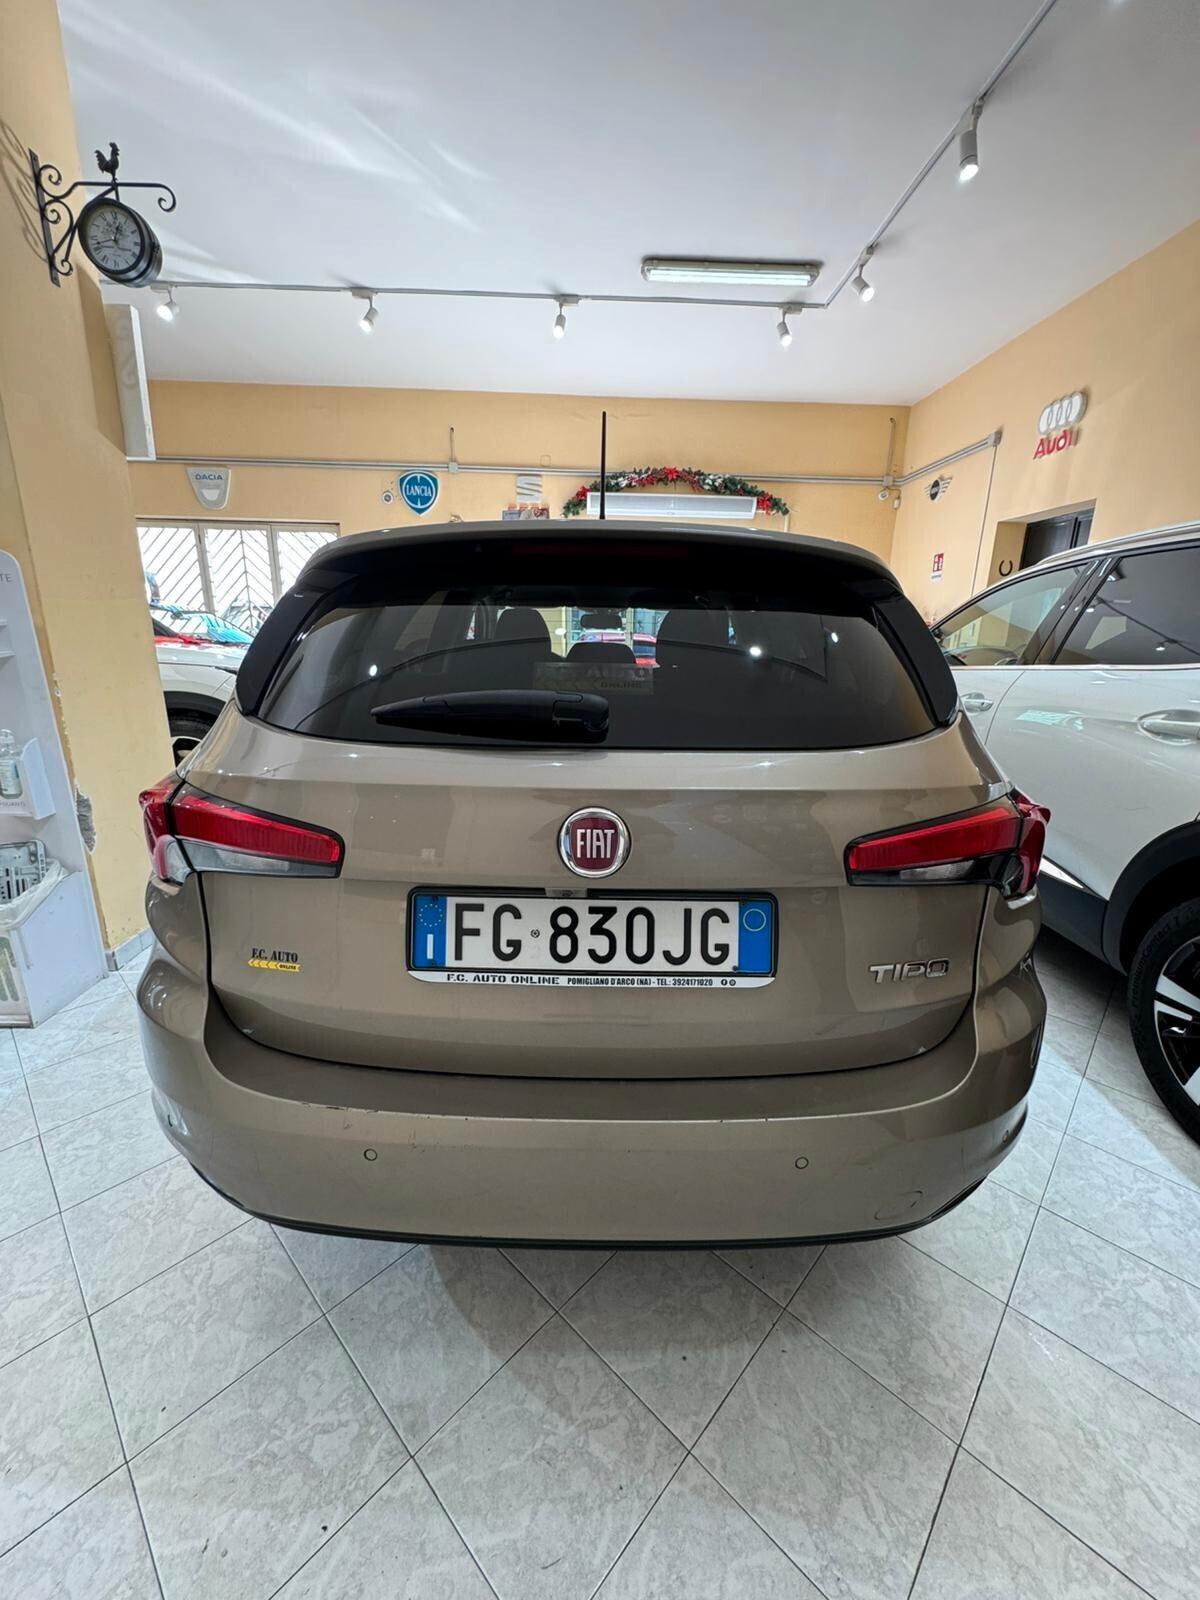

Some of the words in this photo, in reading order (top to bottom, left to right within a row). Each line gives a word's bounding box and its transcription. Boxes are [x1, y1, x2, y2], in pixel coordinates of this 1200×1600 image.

[1033, 430, 1076, 459] Audi
[195, 473, 224, 481] DACIA
[406, 485, 432, 497] LANCIA
[576, 828, 615, 859] FIAT
[426, 933, 434, 960] I
[454, 902, 523, 962] FG
[549, 905, 730, 966] 830JG
[251, 948, 268, 960] F.C.
[271, 950, 298, 962] AUTO
[447, 973, 468, 982] F.C.
[473, 974, 507, 983] AUTO
[511, 976, 560, 985] ONLINE
[567, 977, 609, 985] POMIGLIANO
[610, 977, 635, 985] D'ARCO
[636, 977, 652, 986] (NA)
[672, 978, 713, 987] 3924171020
[869, 958, 950, 983] TIPO
